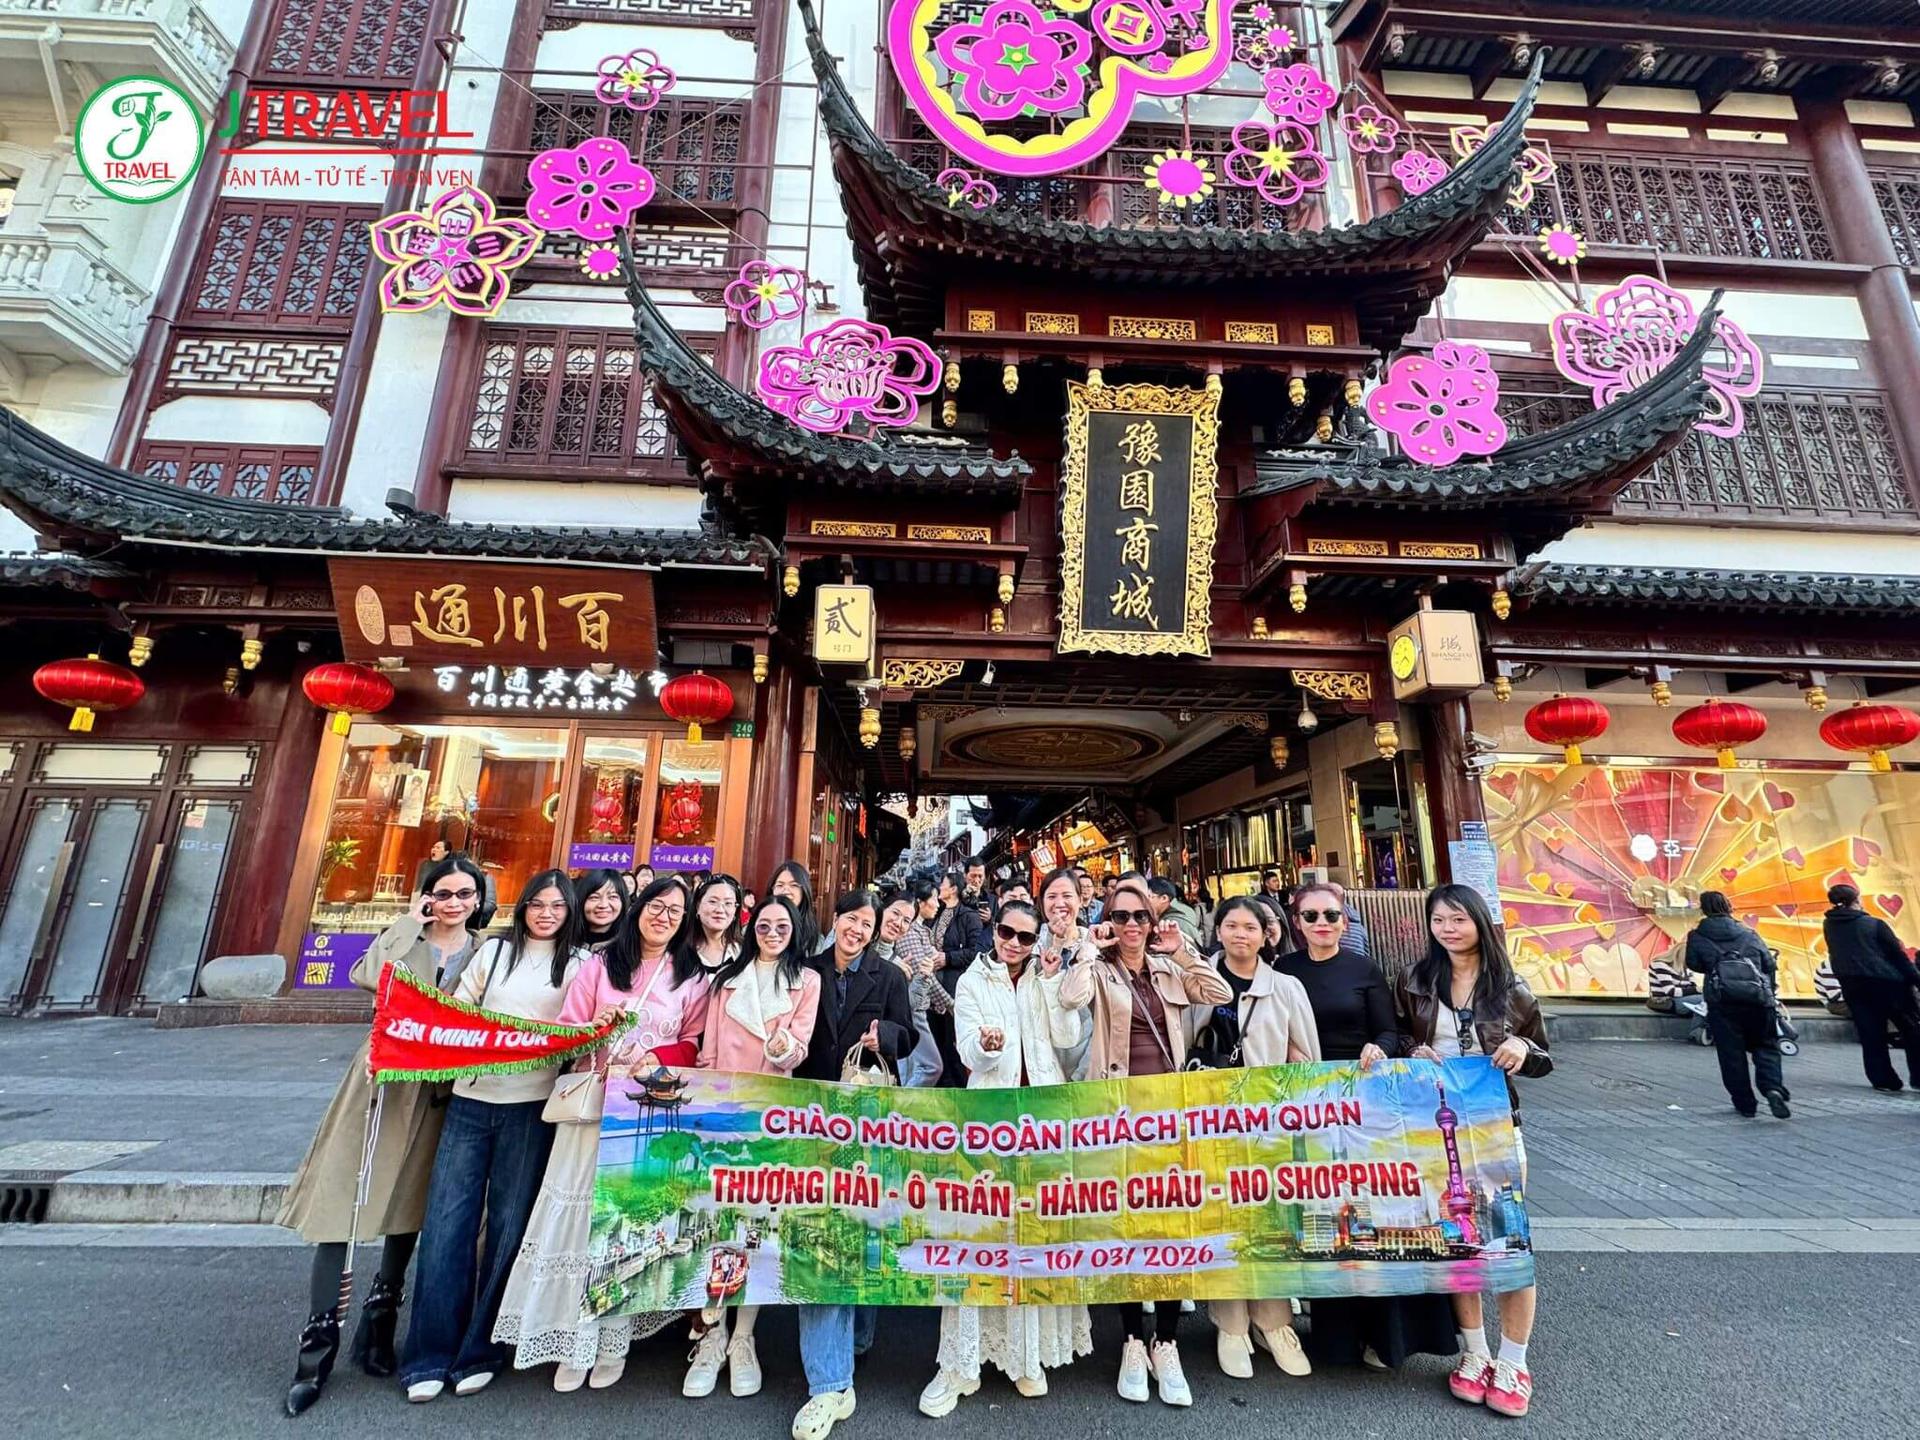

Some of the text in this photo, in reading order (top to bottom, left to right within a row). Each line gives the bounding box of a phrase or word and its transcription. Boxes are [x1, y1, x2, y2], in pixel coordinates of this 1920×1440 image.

[735, 723, 753, 733] 240
[429, 1026, 490, 1047] MINH
[494, 1031, 549, 1048] TOUR
[764, 1101, 1362, 1151] CHÀO MỪNG ĐOÀN KHÁCH THAM QUAN
[713, 1167, 824, 1212] THƯỢNG
[834, 1165, 879, 1208] HẢI
[908, 1174, 926, 1209] Ô
[935, 1174, 1011, 1217] TRẤN
[1041, 1177, 1118, 1216] HÀNG
[1127, 1168, 1202, 1209] CHÂU
[1230, 1169, 1268, 1204] NO
[1278, 1162, 1421, 1199] SHOPPING
[1143, 1244, 1214, 1267] 2026
